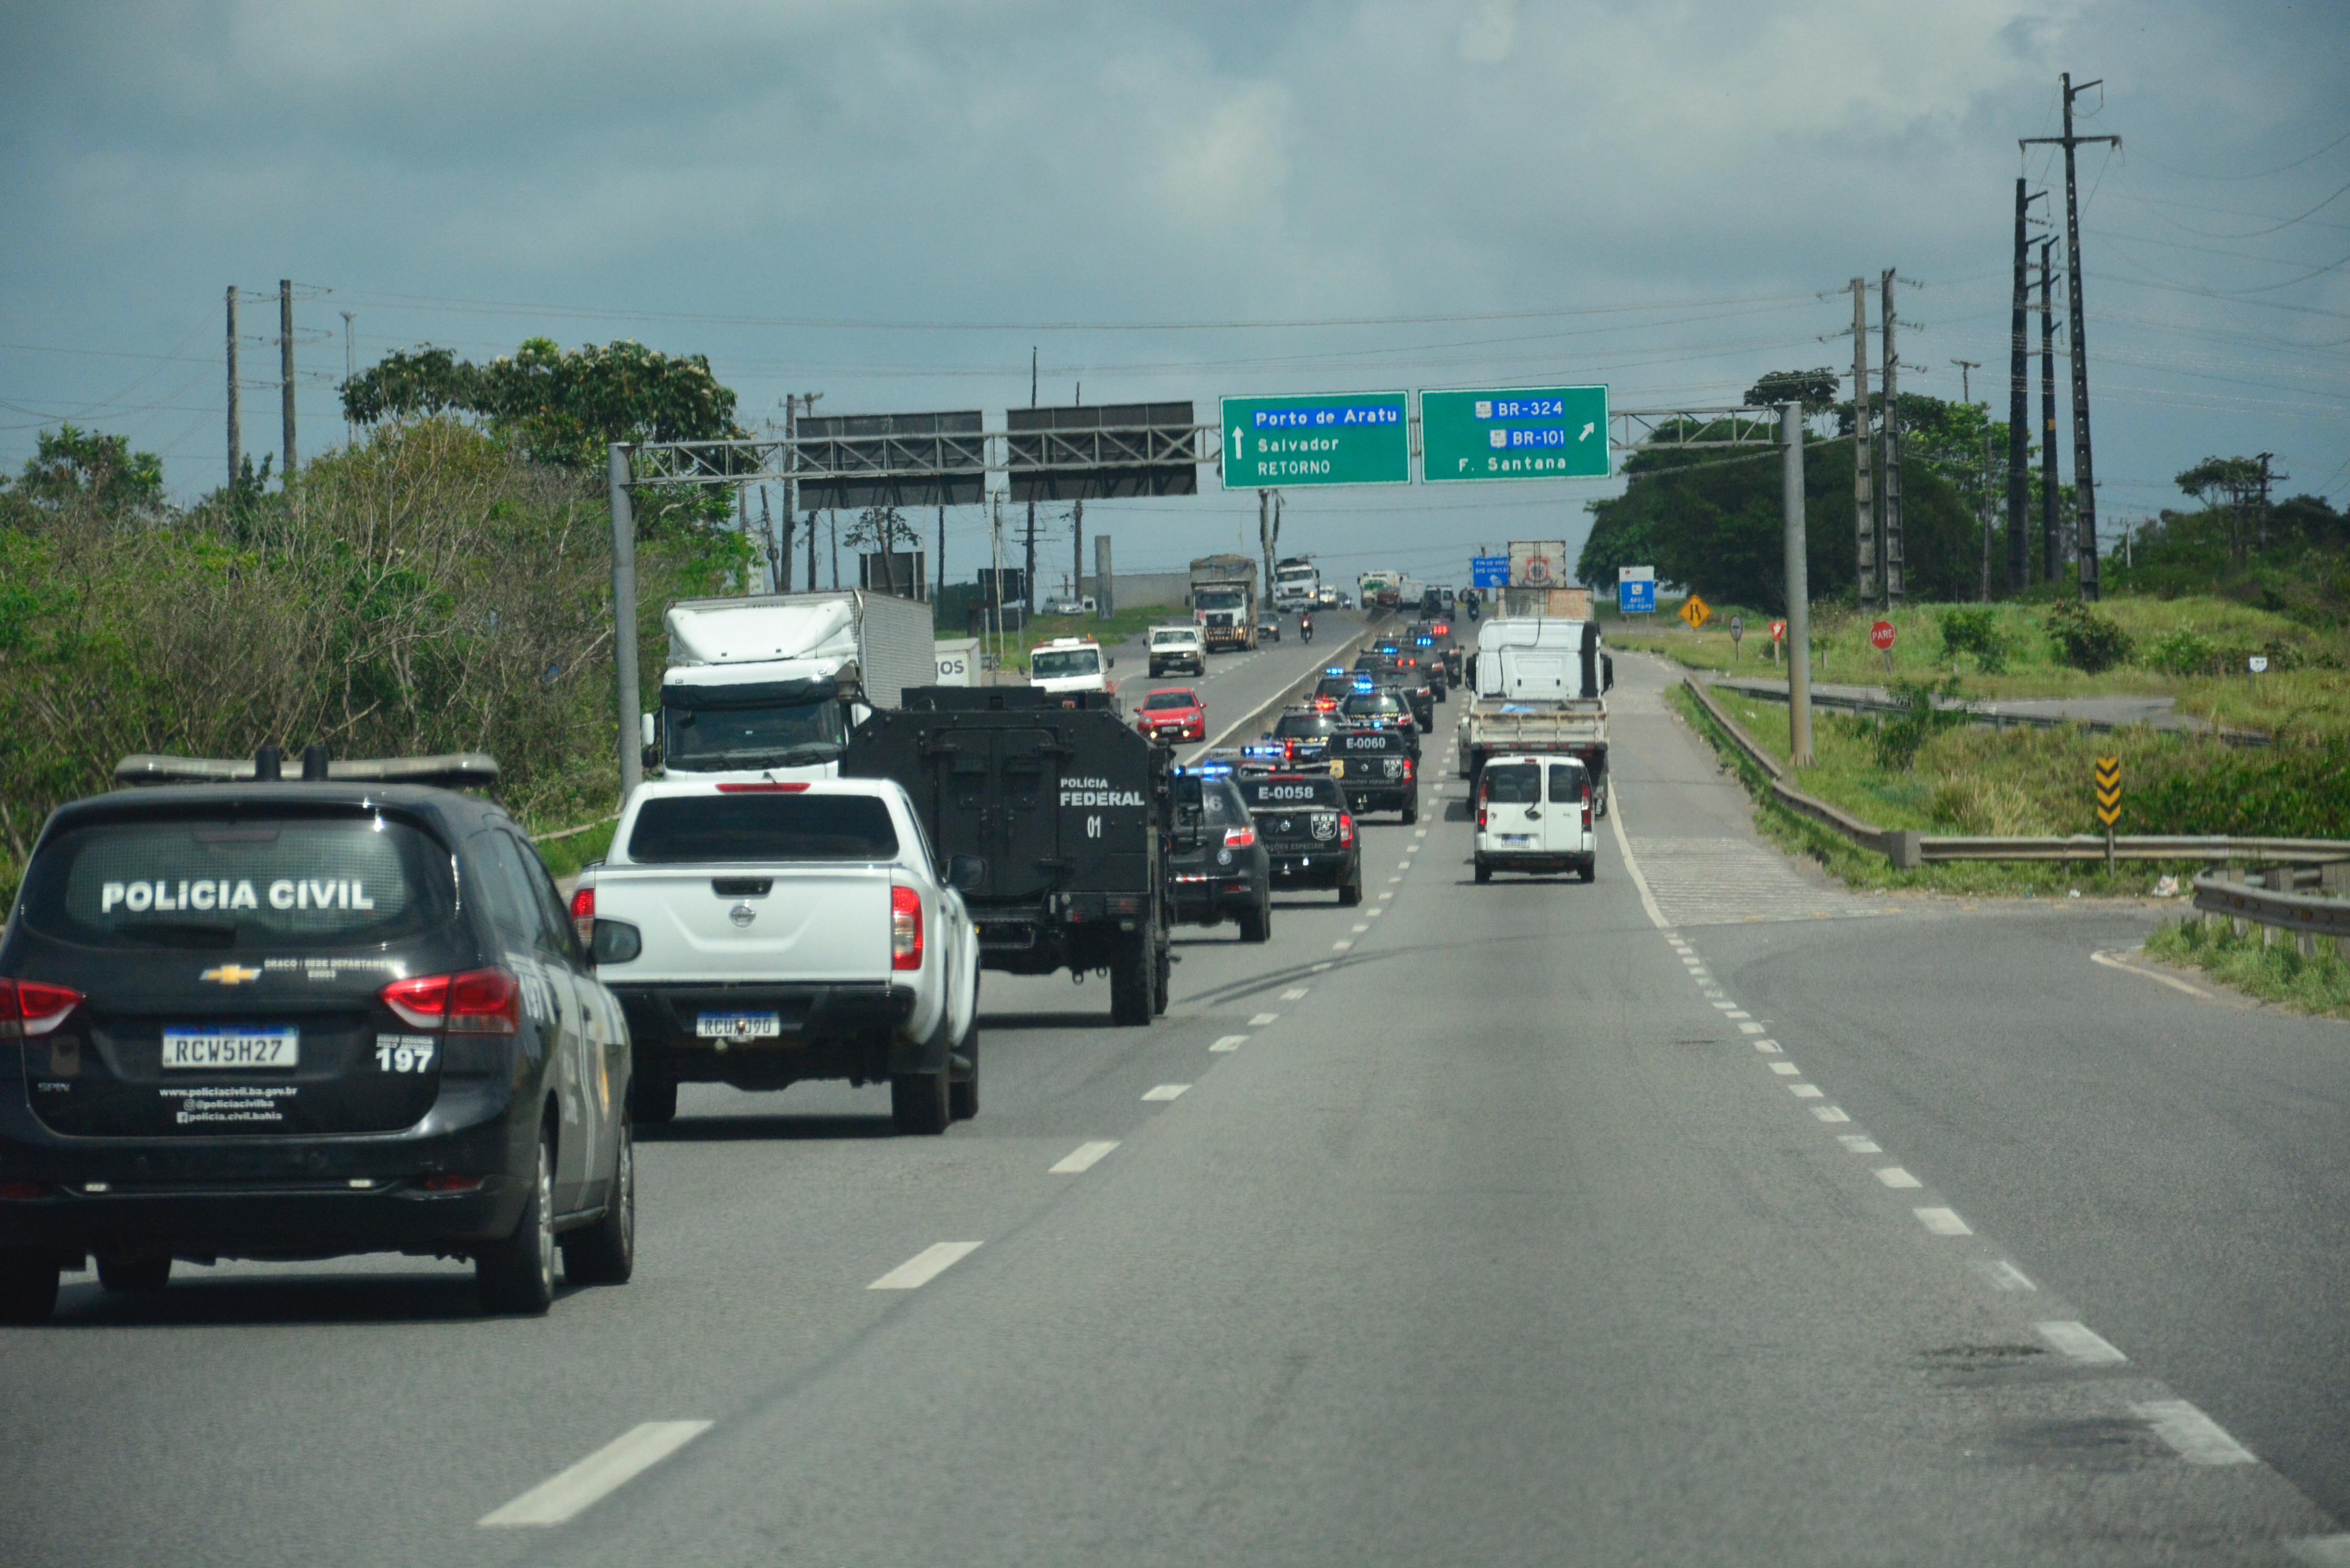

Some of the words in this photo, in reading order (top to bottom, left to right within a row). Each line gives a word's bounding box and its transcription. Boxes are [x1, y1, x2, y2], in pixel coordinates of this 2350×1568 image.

[1499, 401, 1563, 416] BR-324
[1256, 412, 1308, 426] Porto
[1316, 411, 1335, 424] de
[1344, 408, 1397, 423] Aratu
[1258, 437, 1339, 452] Salvador
[1513, 430, 1564, 446] BR-101
[1258, 460, 1330, 476] RETORNO
[1459, 458, 1474, 472] F.
[1488, 456, 1566, 471] Santana
[1872, 629, 1894, 642] PARE
[1346, 737, 1386, 749] E-0060
[1060, 776, 1108, 789] POLÍCIA
[1060, 792, 1145, 807] FEDERAL
[1258, 786, 1314, 800] E-0058
[1087, 816, 1101, 838] 01
[269, 879, 374, 910] CIVIL
[176, 1039, 282, 1062] RCW5H27
[376, 1048, 433, 1073] 197
[159, 1086, 299, 1097] www.policiacivil.ba.gov.br
